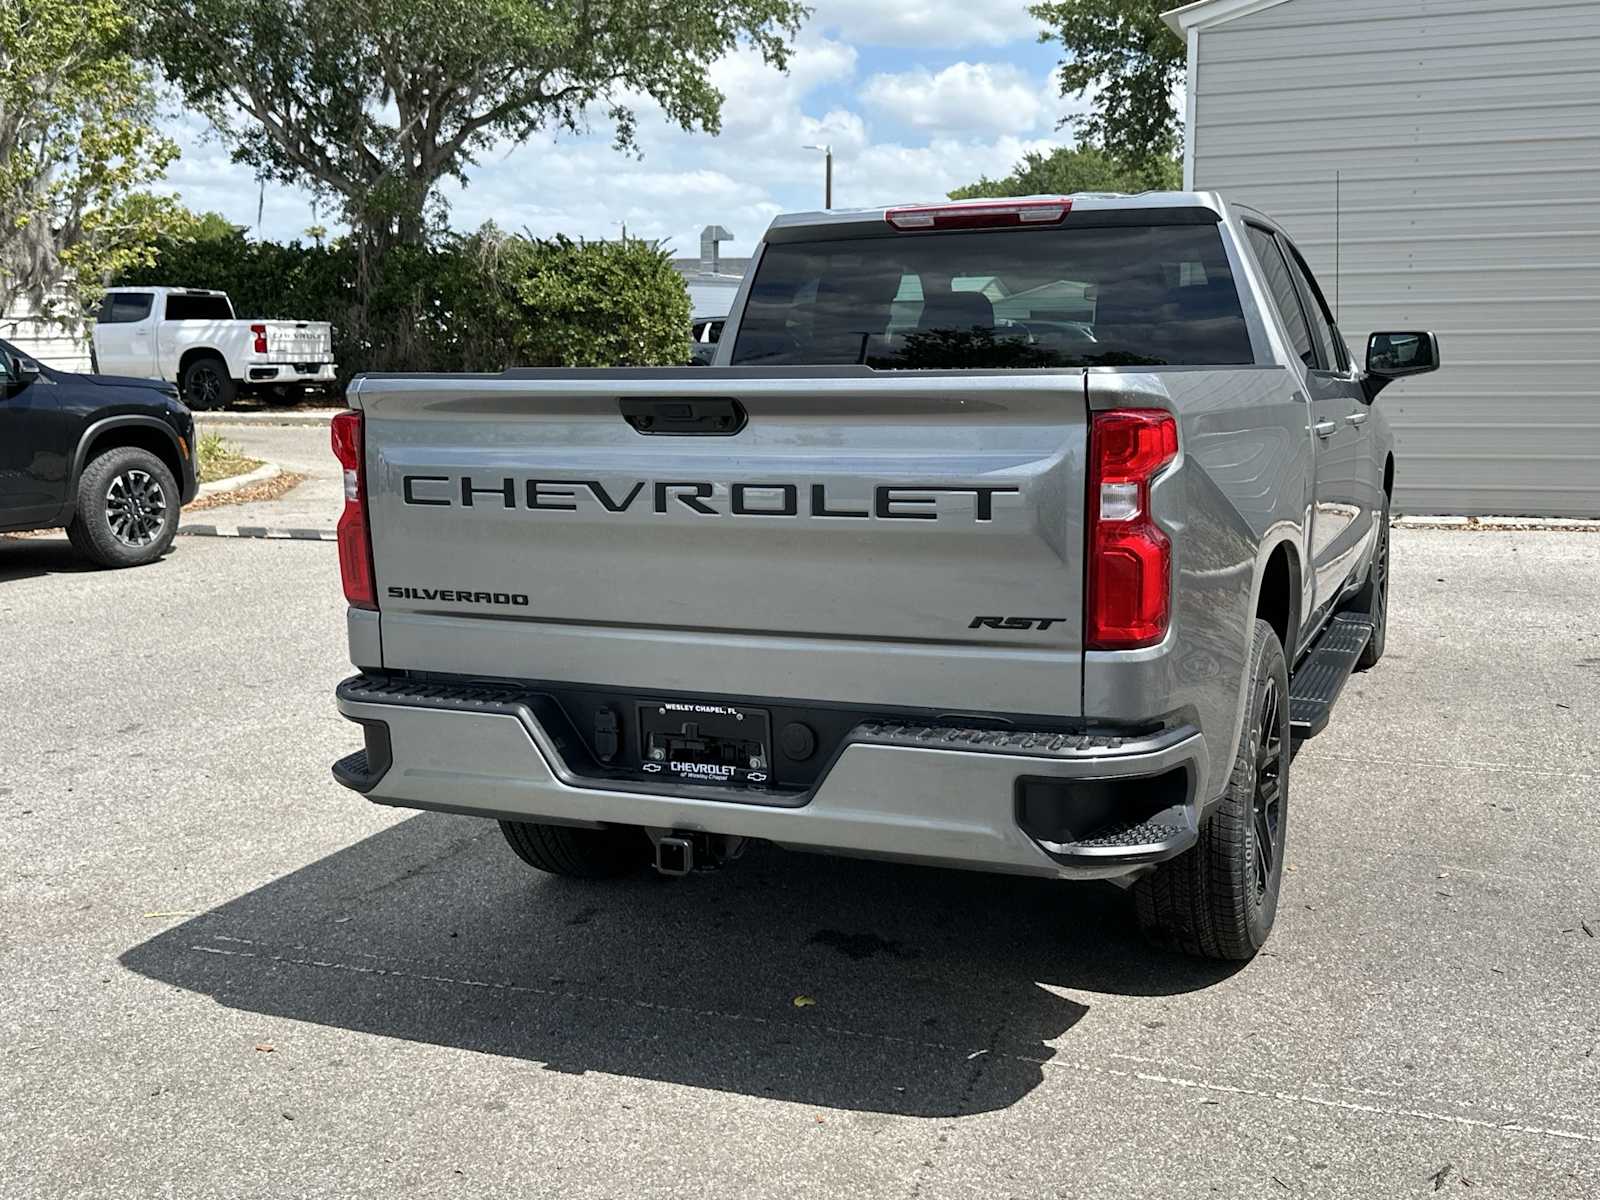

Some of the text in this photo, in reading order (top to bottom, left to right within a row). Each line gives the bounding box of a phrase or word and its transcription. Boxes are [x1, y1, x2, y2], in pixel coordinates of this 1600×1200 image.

[403, 475, 1020, 522] CHEVROLET
[388, 586, 529, 606] SILVERADO
[968, 615, 1067, 630] RST
[665, 703, 694, 711] WESLEY
[695, 705, 727, 715] CHAPEL,
[670, 761, 737, 776] CHEVROLET
